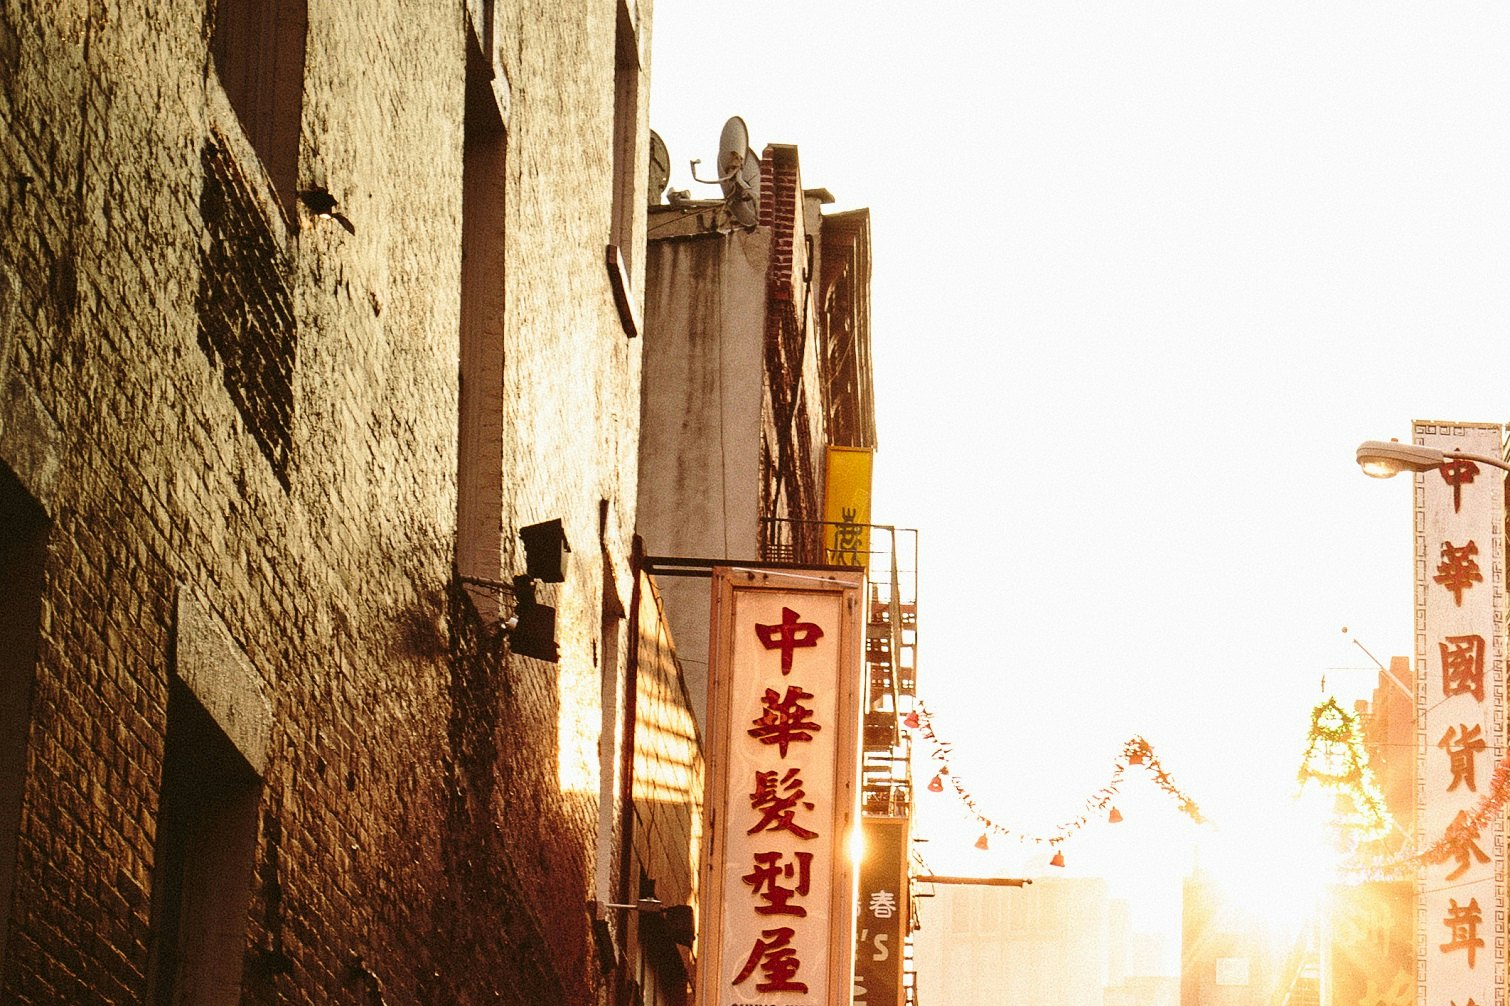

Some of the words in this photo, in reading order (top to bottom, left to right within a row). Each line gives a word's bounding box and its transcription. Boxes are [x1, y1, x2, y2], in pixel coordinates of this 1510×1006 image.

[733, 606, 824, 994] 中華髮型屋
